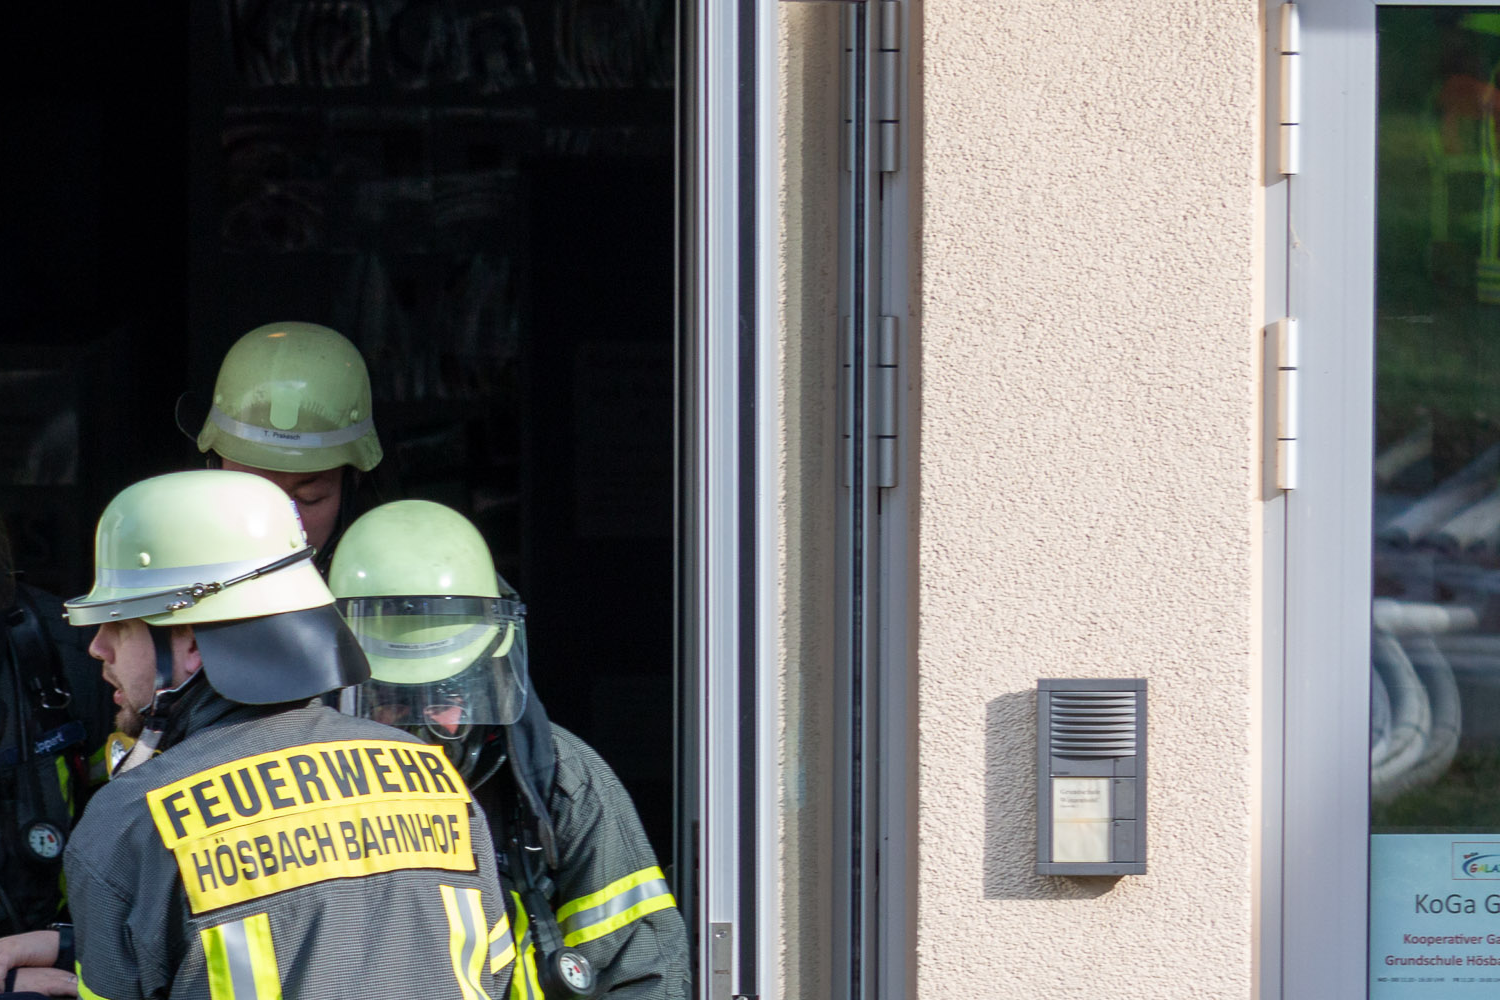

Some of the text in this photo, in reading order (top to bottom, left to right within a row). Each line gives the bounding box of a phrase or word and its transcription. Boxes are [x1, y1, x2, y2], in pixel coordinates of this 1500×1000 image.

[161, 747, 459, 840] FEUERWEHR
[191, 814, 460, 893] HÖSBACH BAHNHOF
[1415, 894, 1476, 914] KoGa
[1403, 933, 1484, 946] Kooperativer
[1385, 955, 1463, 966] Grundschule
